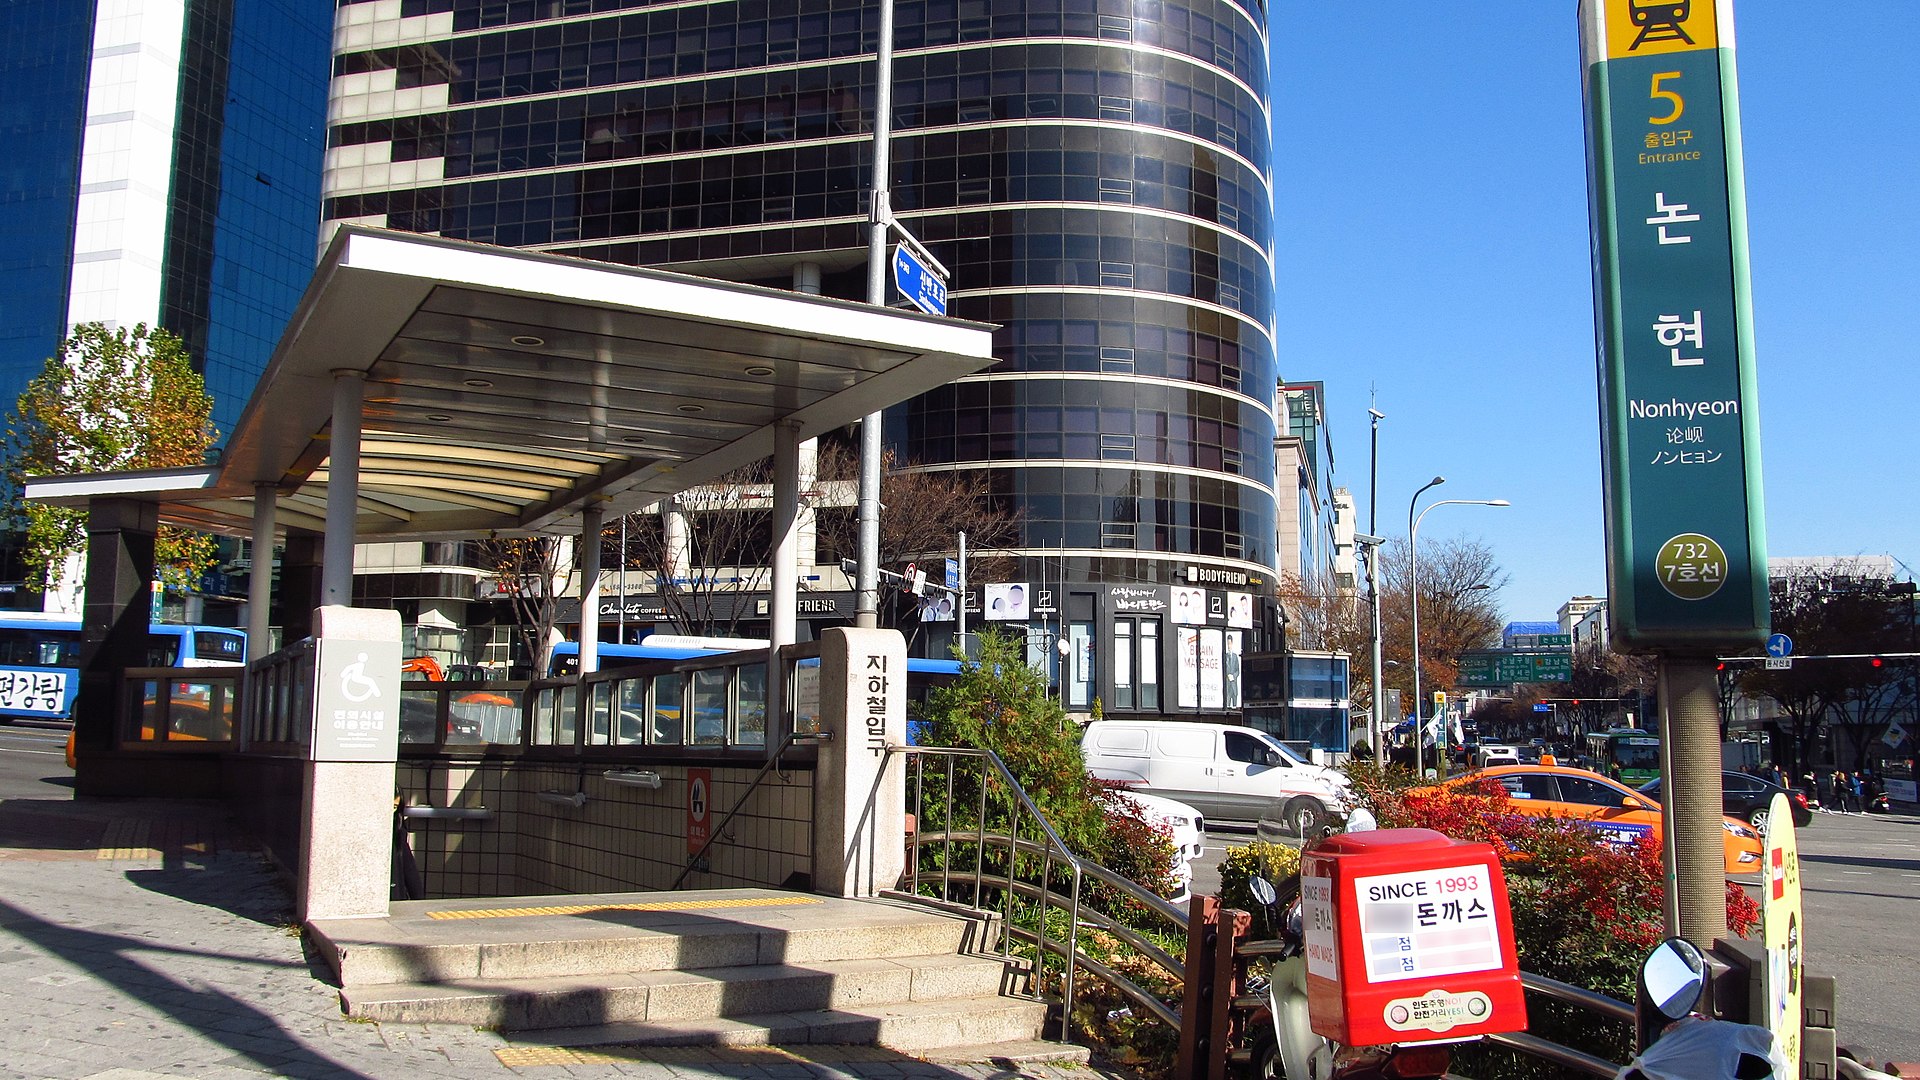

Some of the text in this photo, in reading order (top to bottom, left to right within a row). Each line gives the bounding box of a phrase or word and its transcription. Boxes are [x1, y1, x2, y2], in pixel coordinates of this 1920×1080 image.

[1648, 71, 1685, 125] 5
[1644, 130, 1694, 148] 출입구
[1638, 149, 1701, 165] Entrance
[1629, 398, 1739, 421] Nonhyeon
[1665, 426, 1704, 444] 论岘
[1650, 450, 1723, 465] ノンヒョン
[1673, 543, 1709, 560] 732
[1199, 568, 1248, 586] BODYFRIEND
[1663, 562, 1720, 584] 7호선
[797, 599, 836, 612] FRIEND
[223, 640, 237, 652] 441
[1190, 645, 1214, 656] BAIN
[566, 658, 578, 666] 401
[1184, 657, 1219, 670] MASAGE
[866, 654, 889, 757] 지하철입구
[1369, 875, 1479, 902] SINCE 1993
[1417, 898, 1488, 927] 돈까스
